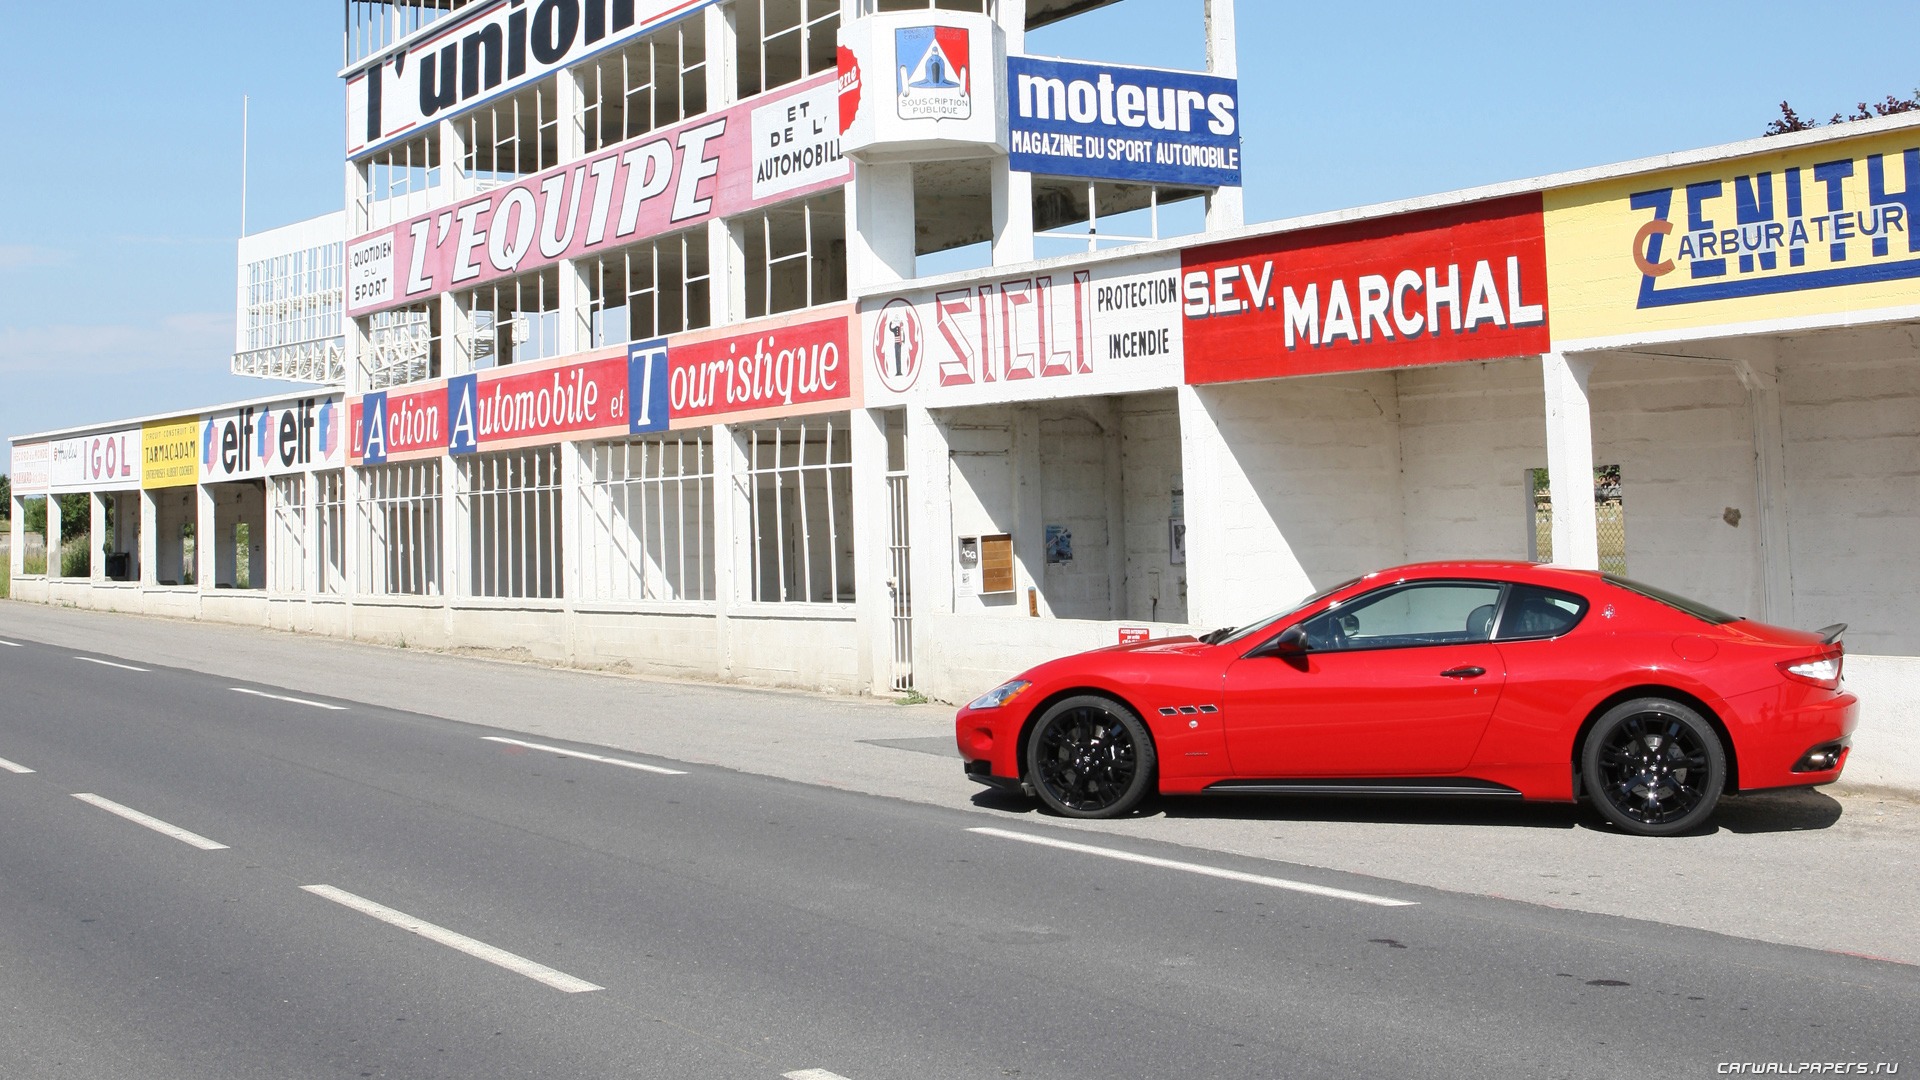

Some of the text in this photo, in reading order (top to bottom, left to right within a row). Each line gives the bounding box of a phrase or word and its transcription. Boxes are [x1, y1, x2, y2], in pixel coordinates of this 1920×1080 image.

[787, 101, 810, 123] ET
[901, 97, 968, 107] SOUSCRIPTION
[912, 106, 958, 115] PUBLIQUE
[1018, 73, 1236, 136] moteurs
[770, 115, 828, 148] DE L'
[1012, 130, 1239, 170] MAGAZINE DU SPORT AUTOMOBILE
[405, 116, 728, 296] L'EQUIPE
[1629, 147, 1920, 310] ZENITH
[1632, 202, 1905, 278] CARBURATEUR
[353, 240, 392, 268] QUOTIDIEN
[364, 267, 377, 278] DU
[354, 277, 388, 301] SPORT
[1183, 256, 1545, 351] S.E.V. MARCHAL
[935, 269, 1177, 387] SICLI PROTECTION
[1108, 327, 1170, 360] INCENDIE
[353, 335, 840, 459] L'Action Automobile et Touristique
[145, 440, 196, 463] TARMACADAM
[222, 406, 254, 475] elf
[279, 398, 315, 467] elf
[83, 435, 131, 481] IGOL
